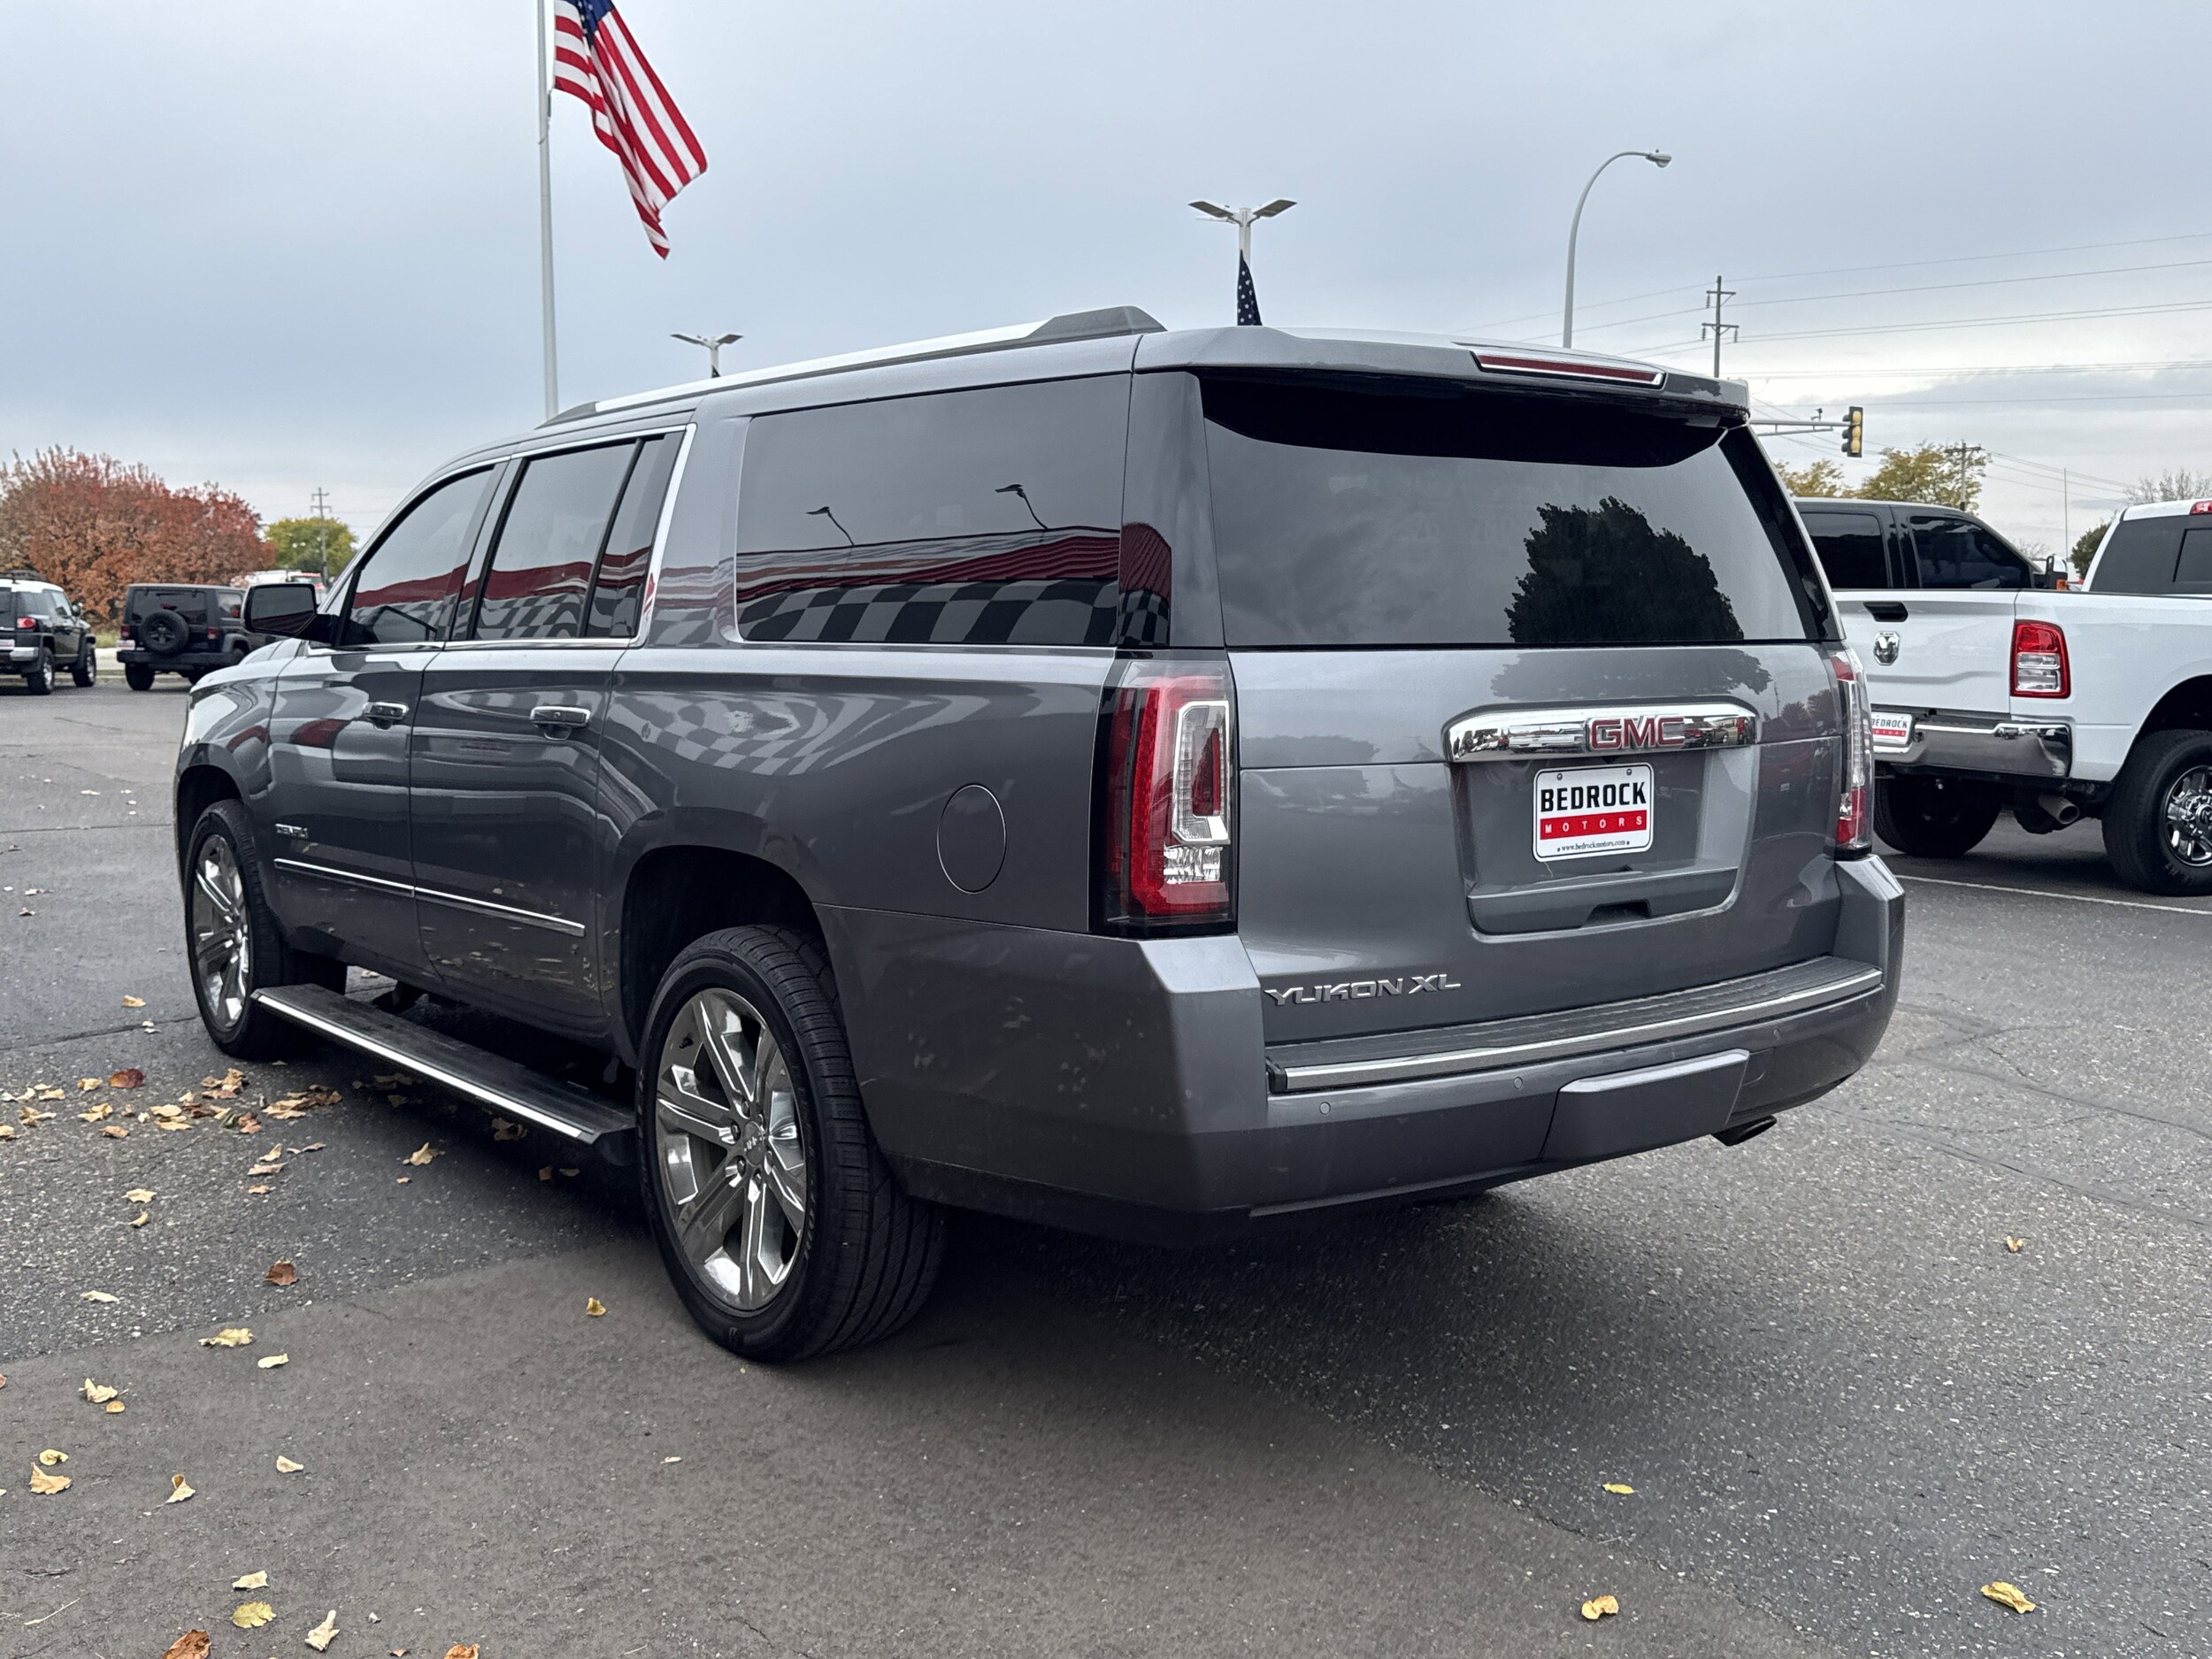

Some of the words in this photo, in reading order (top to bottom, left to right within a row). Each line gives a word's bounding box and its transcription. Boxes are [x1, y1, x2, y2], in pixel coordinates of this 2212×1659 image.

[1590, 716, 1685, 750] GMC
[1540, 781, 1647, 812] BEDROCK
[1545, 816, 1642, 833] MOTORS
[1561, 840, 1626, 851] www.bedrockmotors.com
[1263, 978, 1403, 1006] YUKON
[1409, 974, 1461, 995] XL
